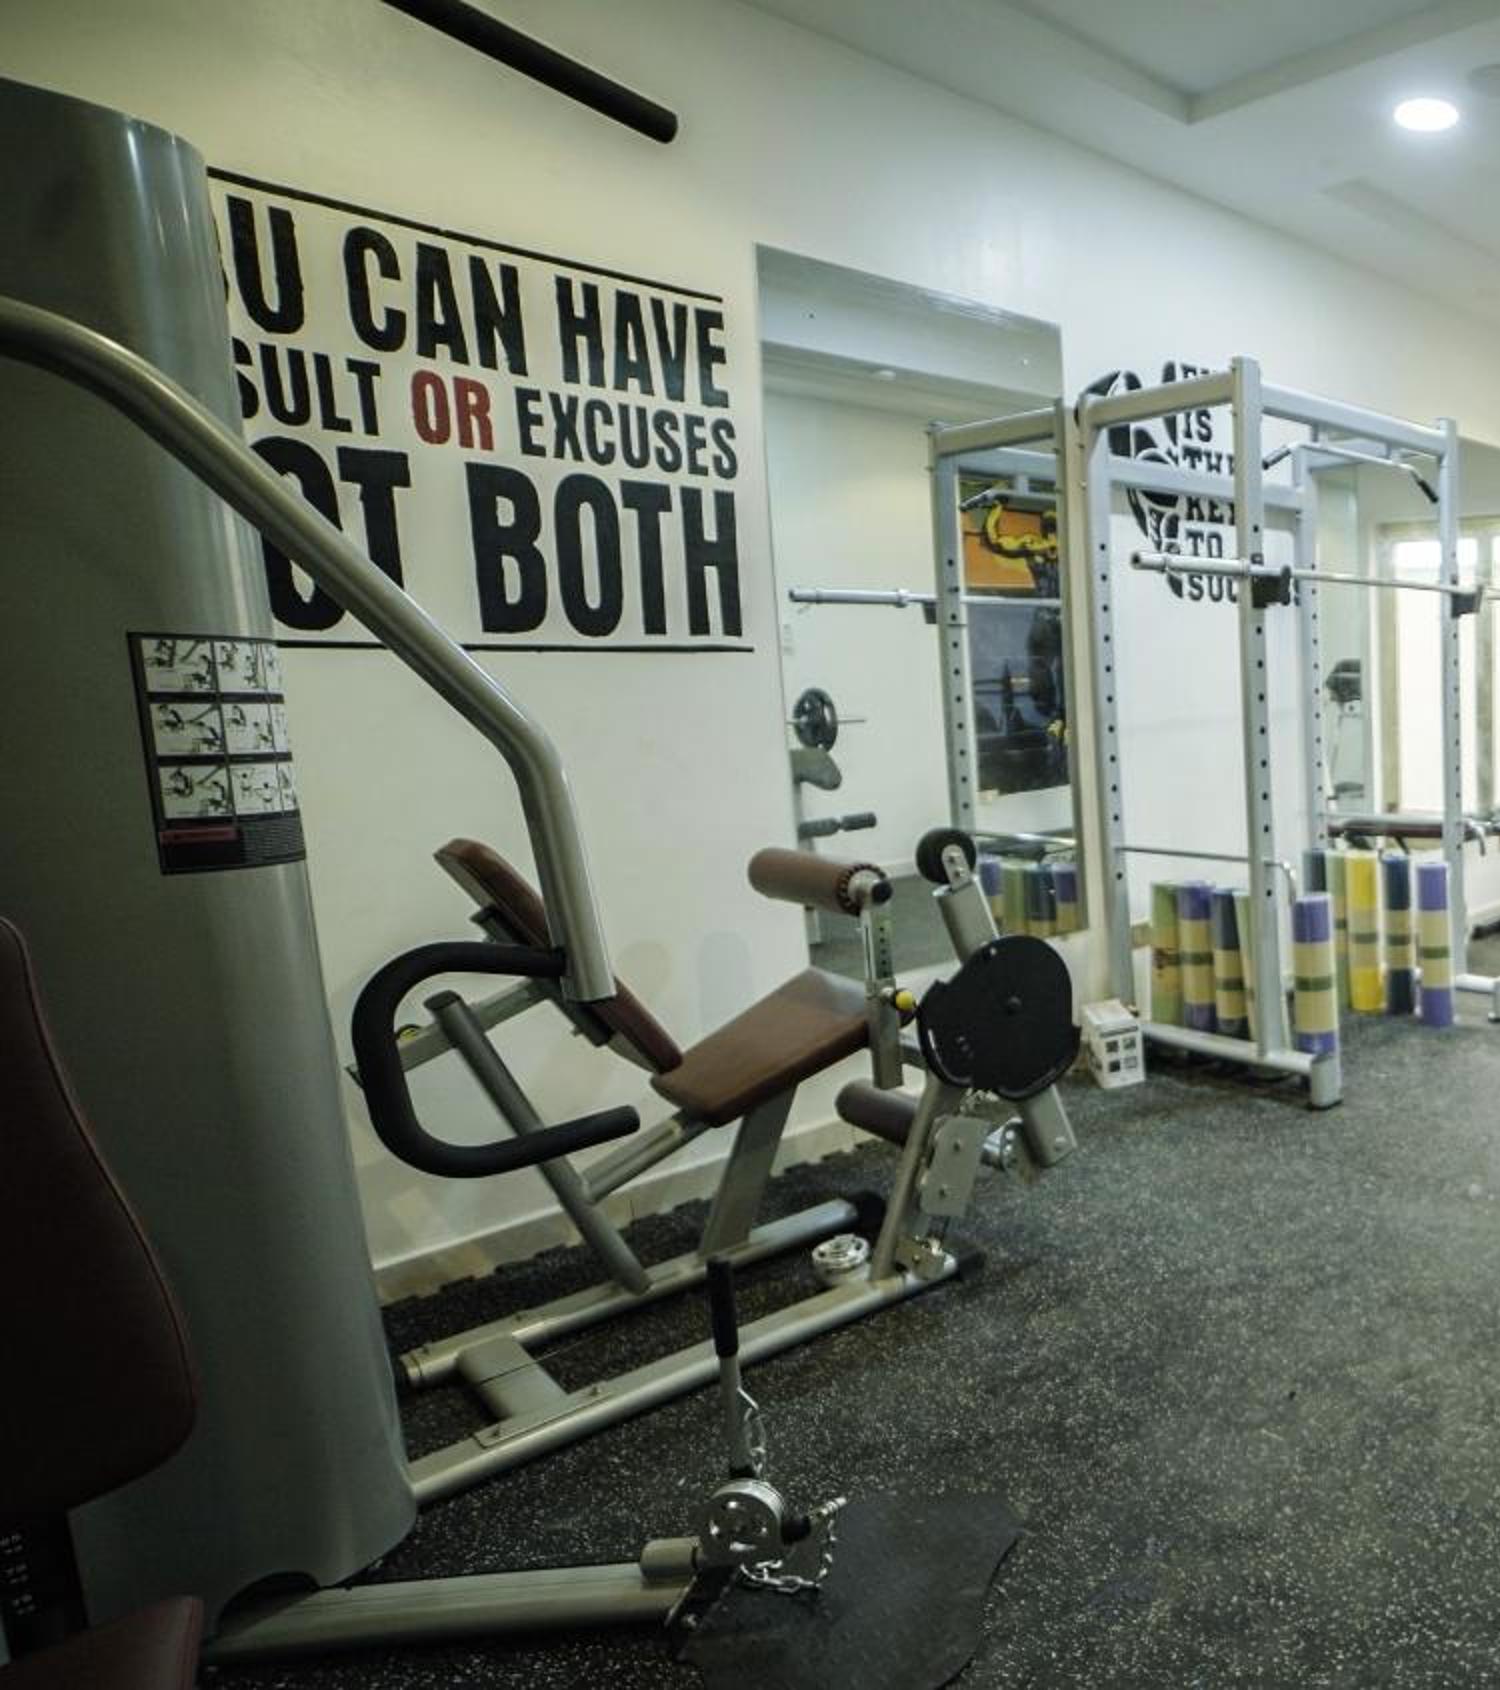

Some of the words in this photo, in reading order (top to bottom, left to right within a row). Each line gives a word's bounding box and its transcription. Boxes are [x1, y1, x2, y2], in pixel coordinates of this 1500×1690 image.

[216, 195, 304, 335] U
[343, 226, 528, 377] CAN
[555, 274, 730, 409] HAVE
[411, 369, 495, 451] OR
[515, 386, 738, 480] EXCUSES
[465, 461, 742, 638] BOTH
